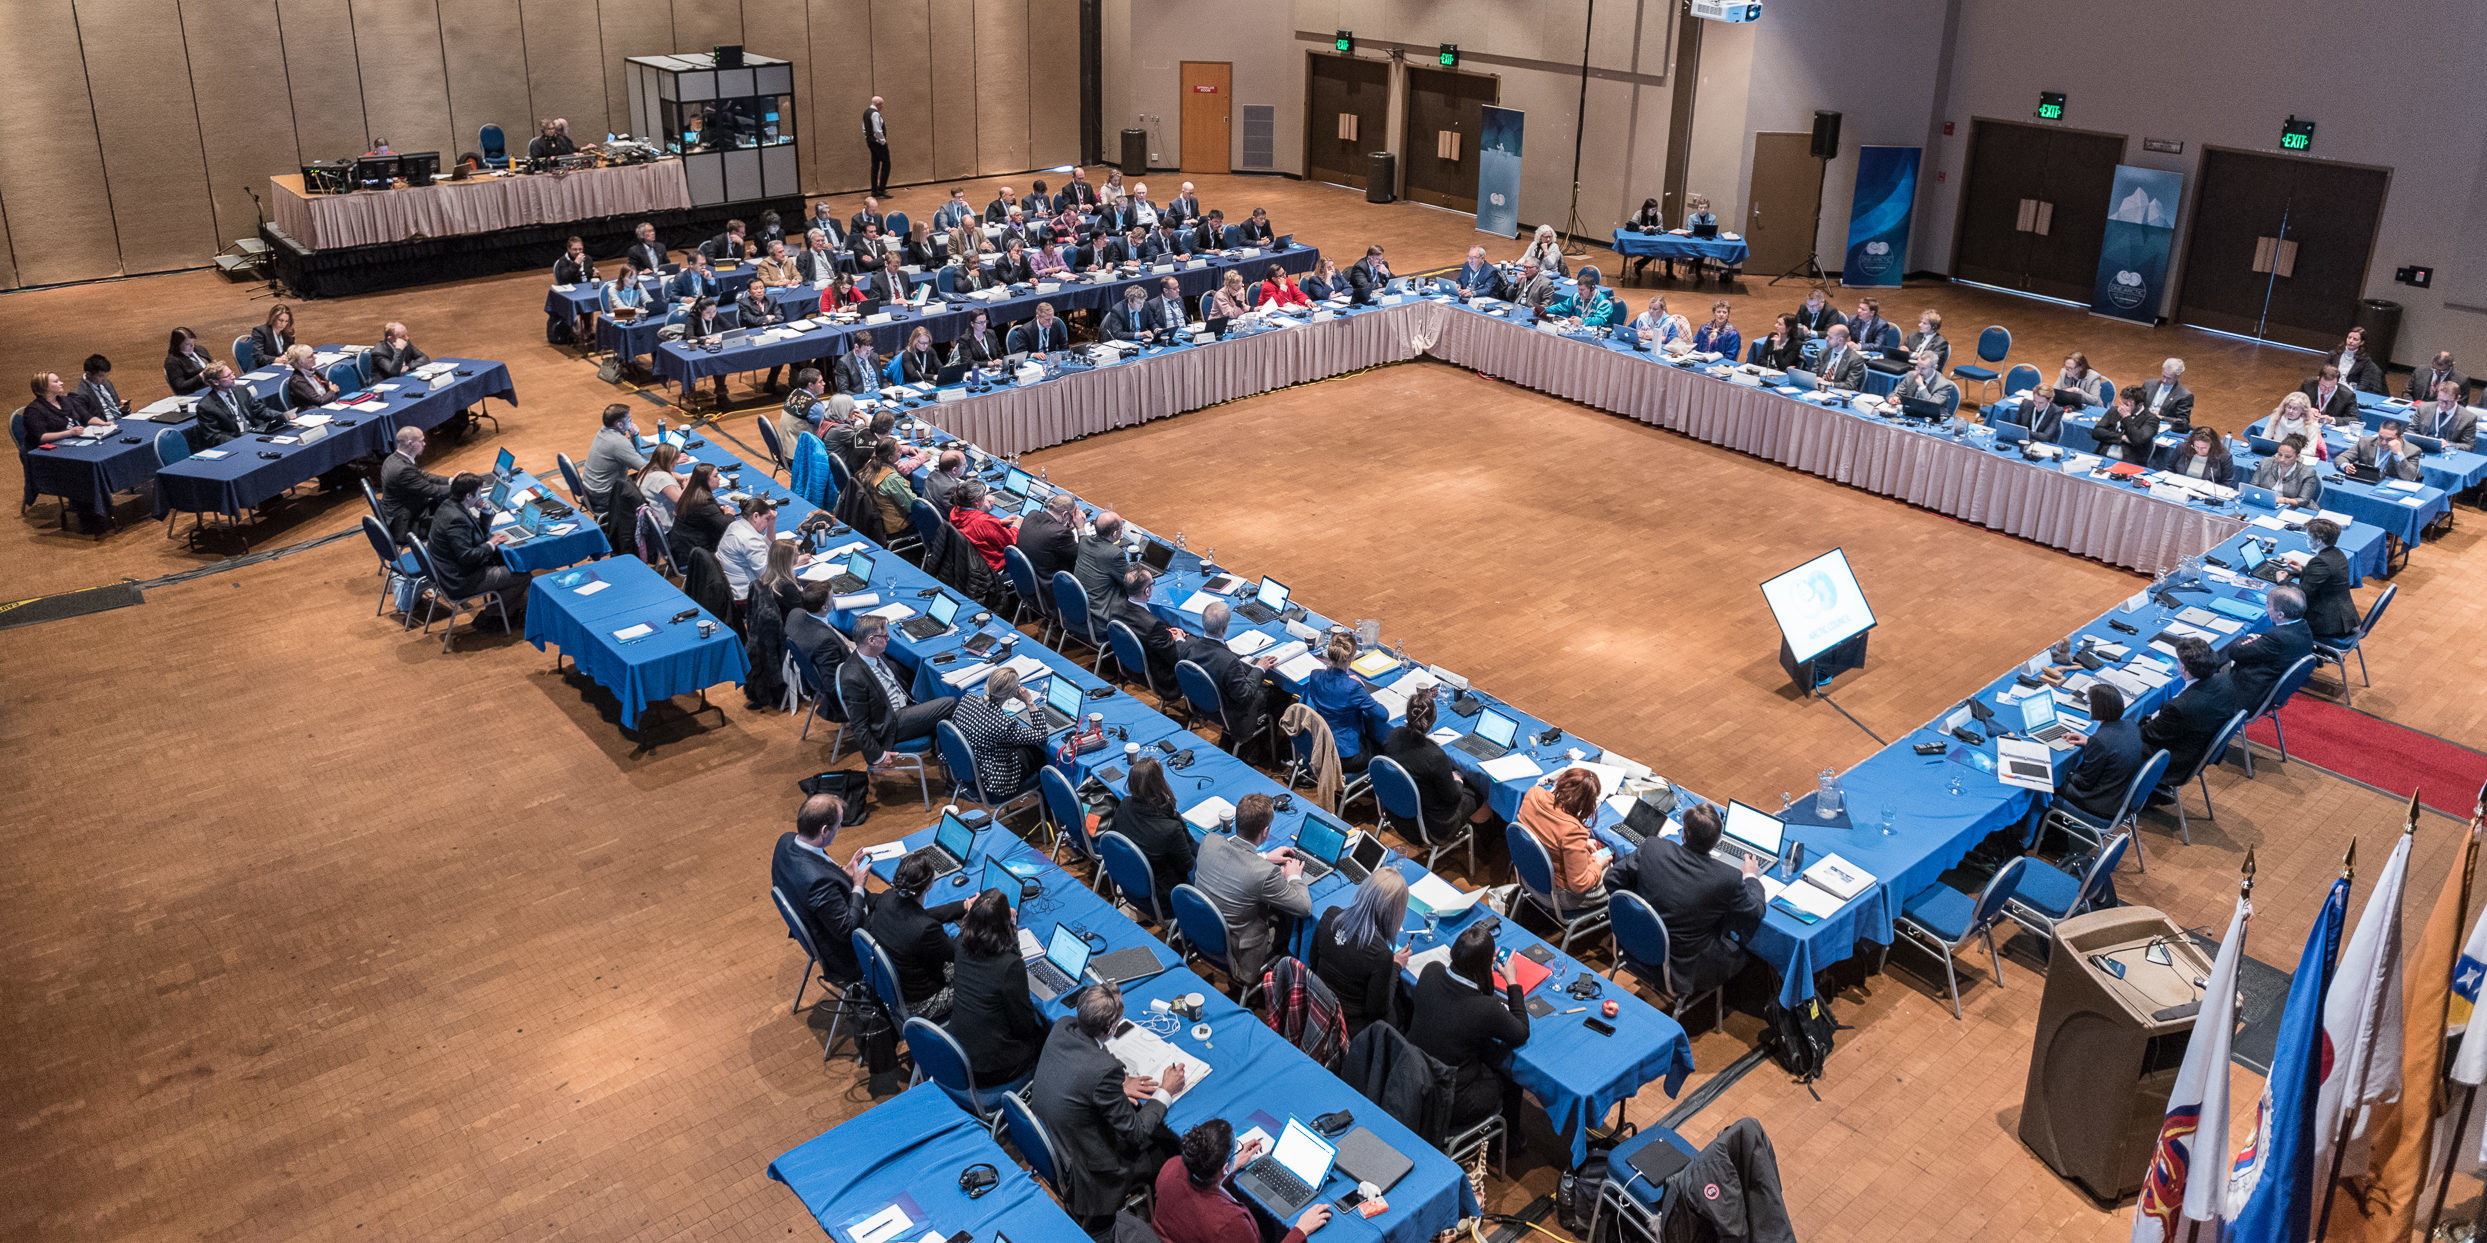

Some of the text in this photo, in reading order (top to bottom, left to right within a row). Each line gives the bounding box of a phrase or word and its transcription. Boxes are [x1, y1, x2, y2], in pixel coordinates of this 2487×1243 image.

[1337, 39, 1349, 51] EXIT
[1441, 53, 1453, 65] EXIT
[2041, 104, 2060, 119] EXIT
[2284, 133, 2307, 149] EXIT
